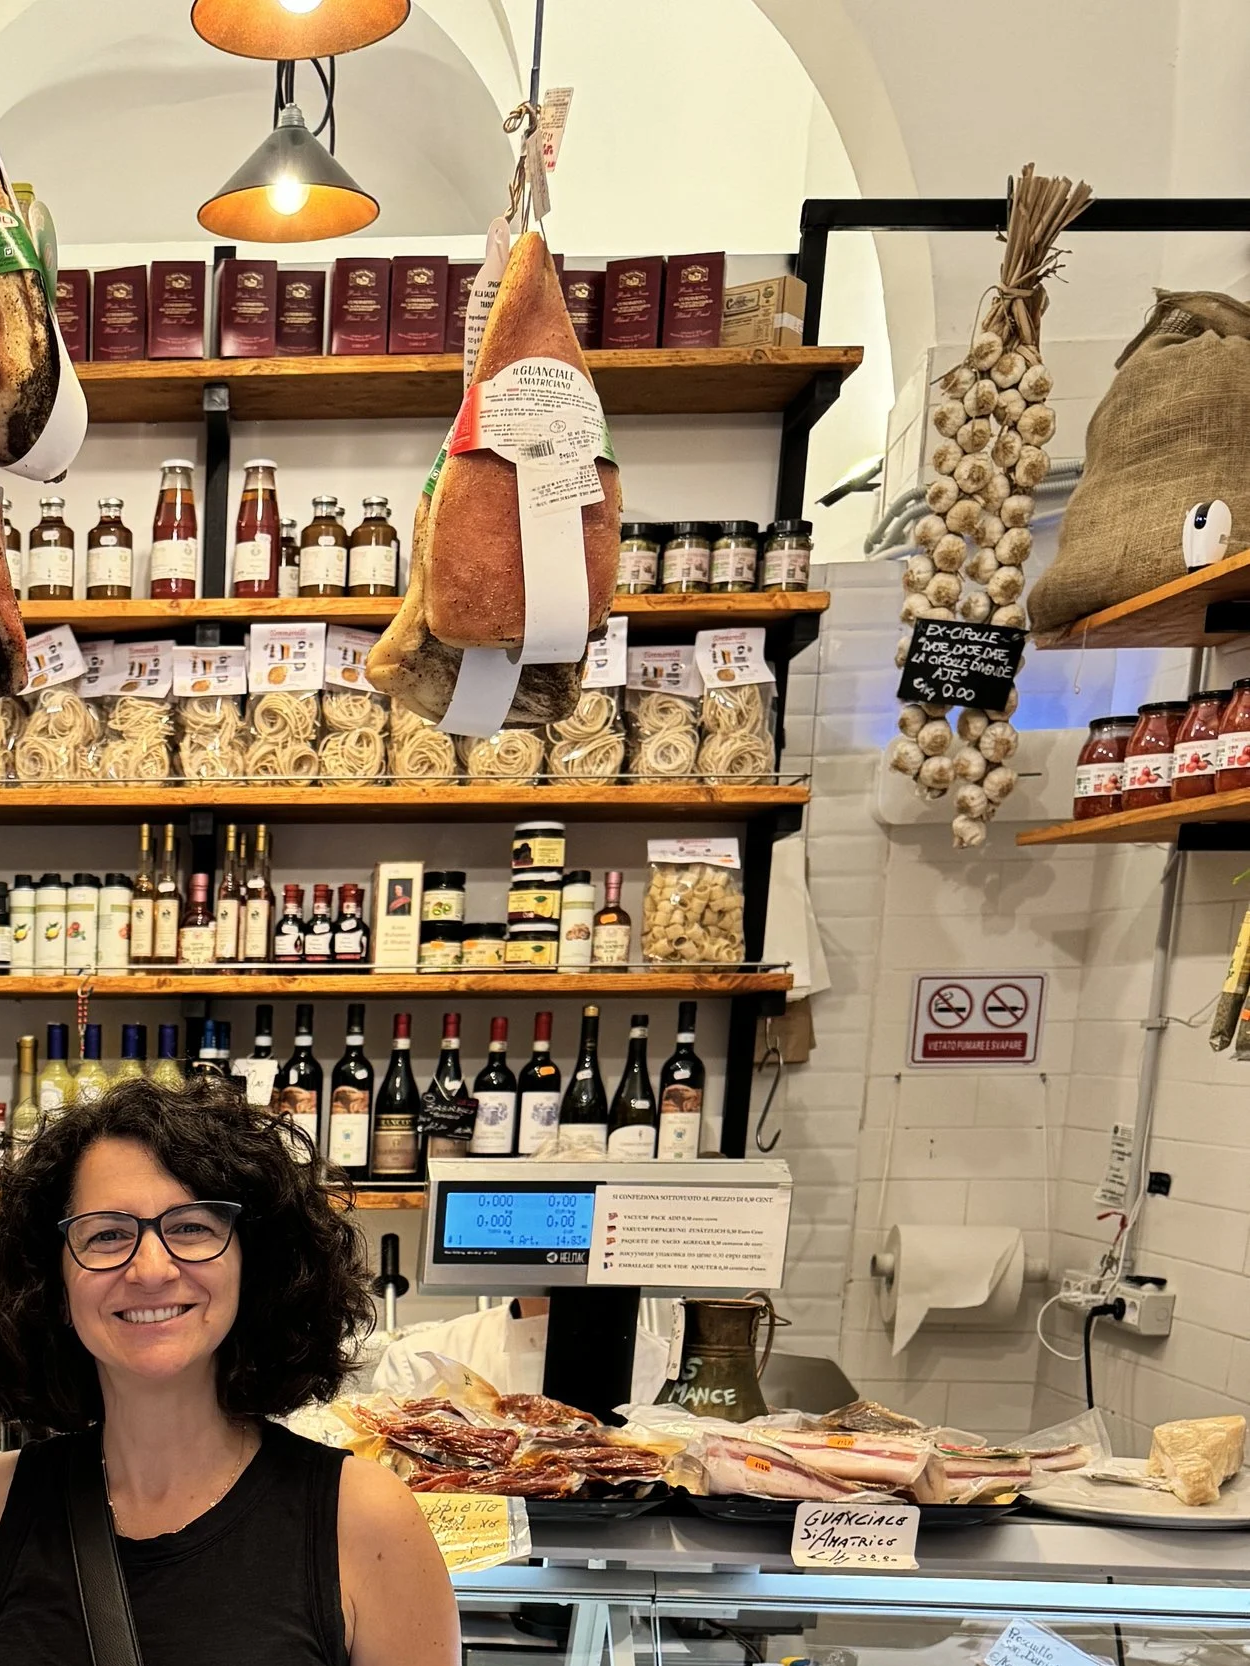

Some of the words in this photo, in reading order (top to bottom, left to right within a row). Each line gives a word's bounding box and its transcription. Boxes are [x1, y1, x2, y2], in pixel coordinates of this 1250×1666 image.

[520, 365, 575, 382] GUANCIALE
[517, 378, 571, 389] AMATRICIANO
[927, 1040, 956, 1051] VIETATO
[957, 1040, 984, 1051] FUMARE
[991, 1040, 1023, 1050] SVAPARE
[479, 1195, 514, 1207] 0,000
[548, 1195, 577, 1207] 0,00
[477, 1215, 512, 1227] 0,000
[546, 1215, 575, 1227] 0,00
[667, 1382, 737, 1407] MANCE
